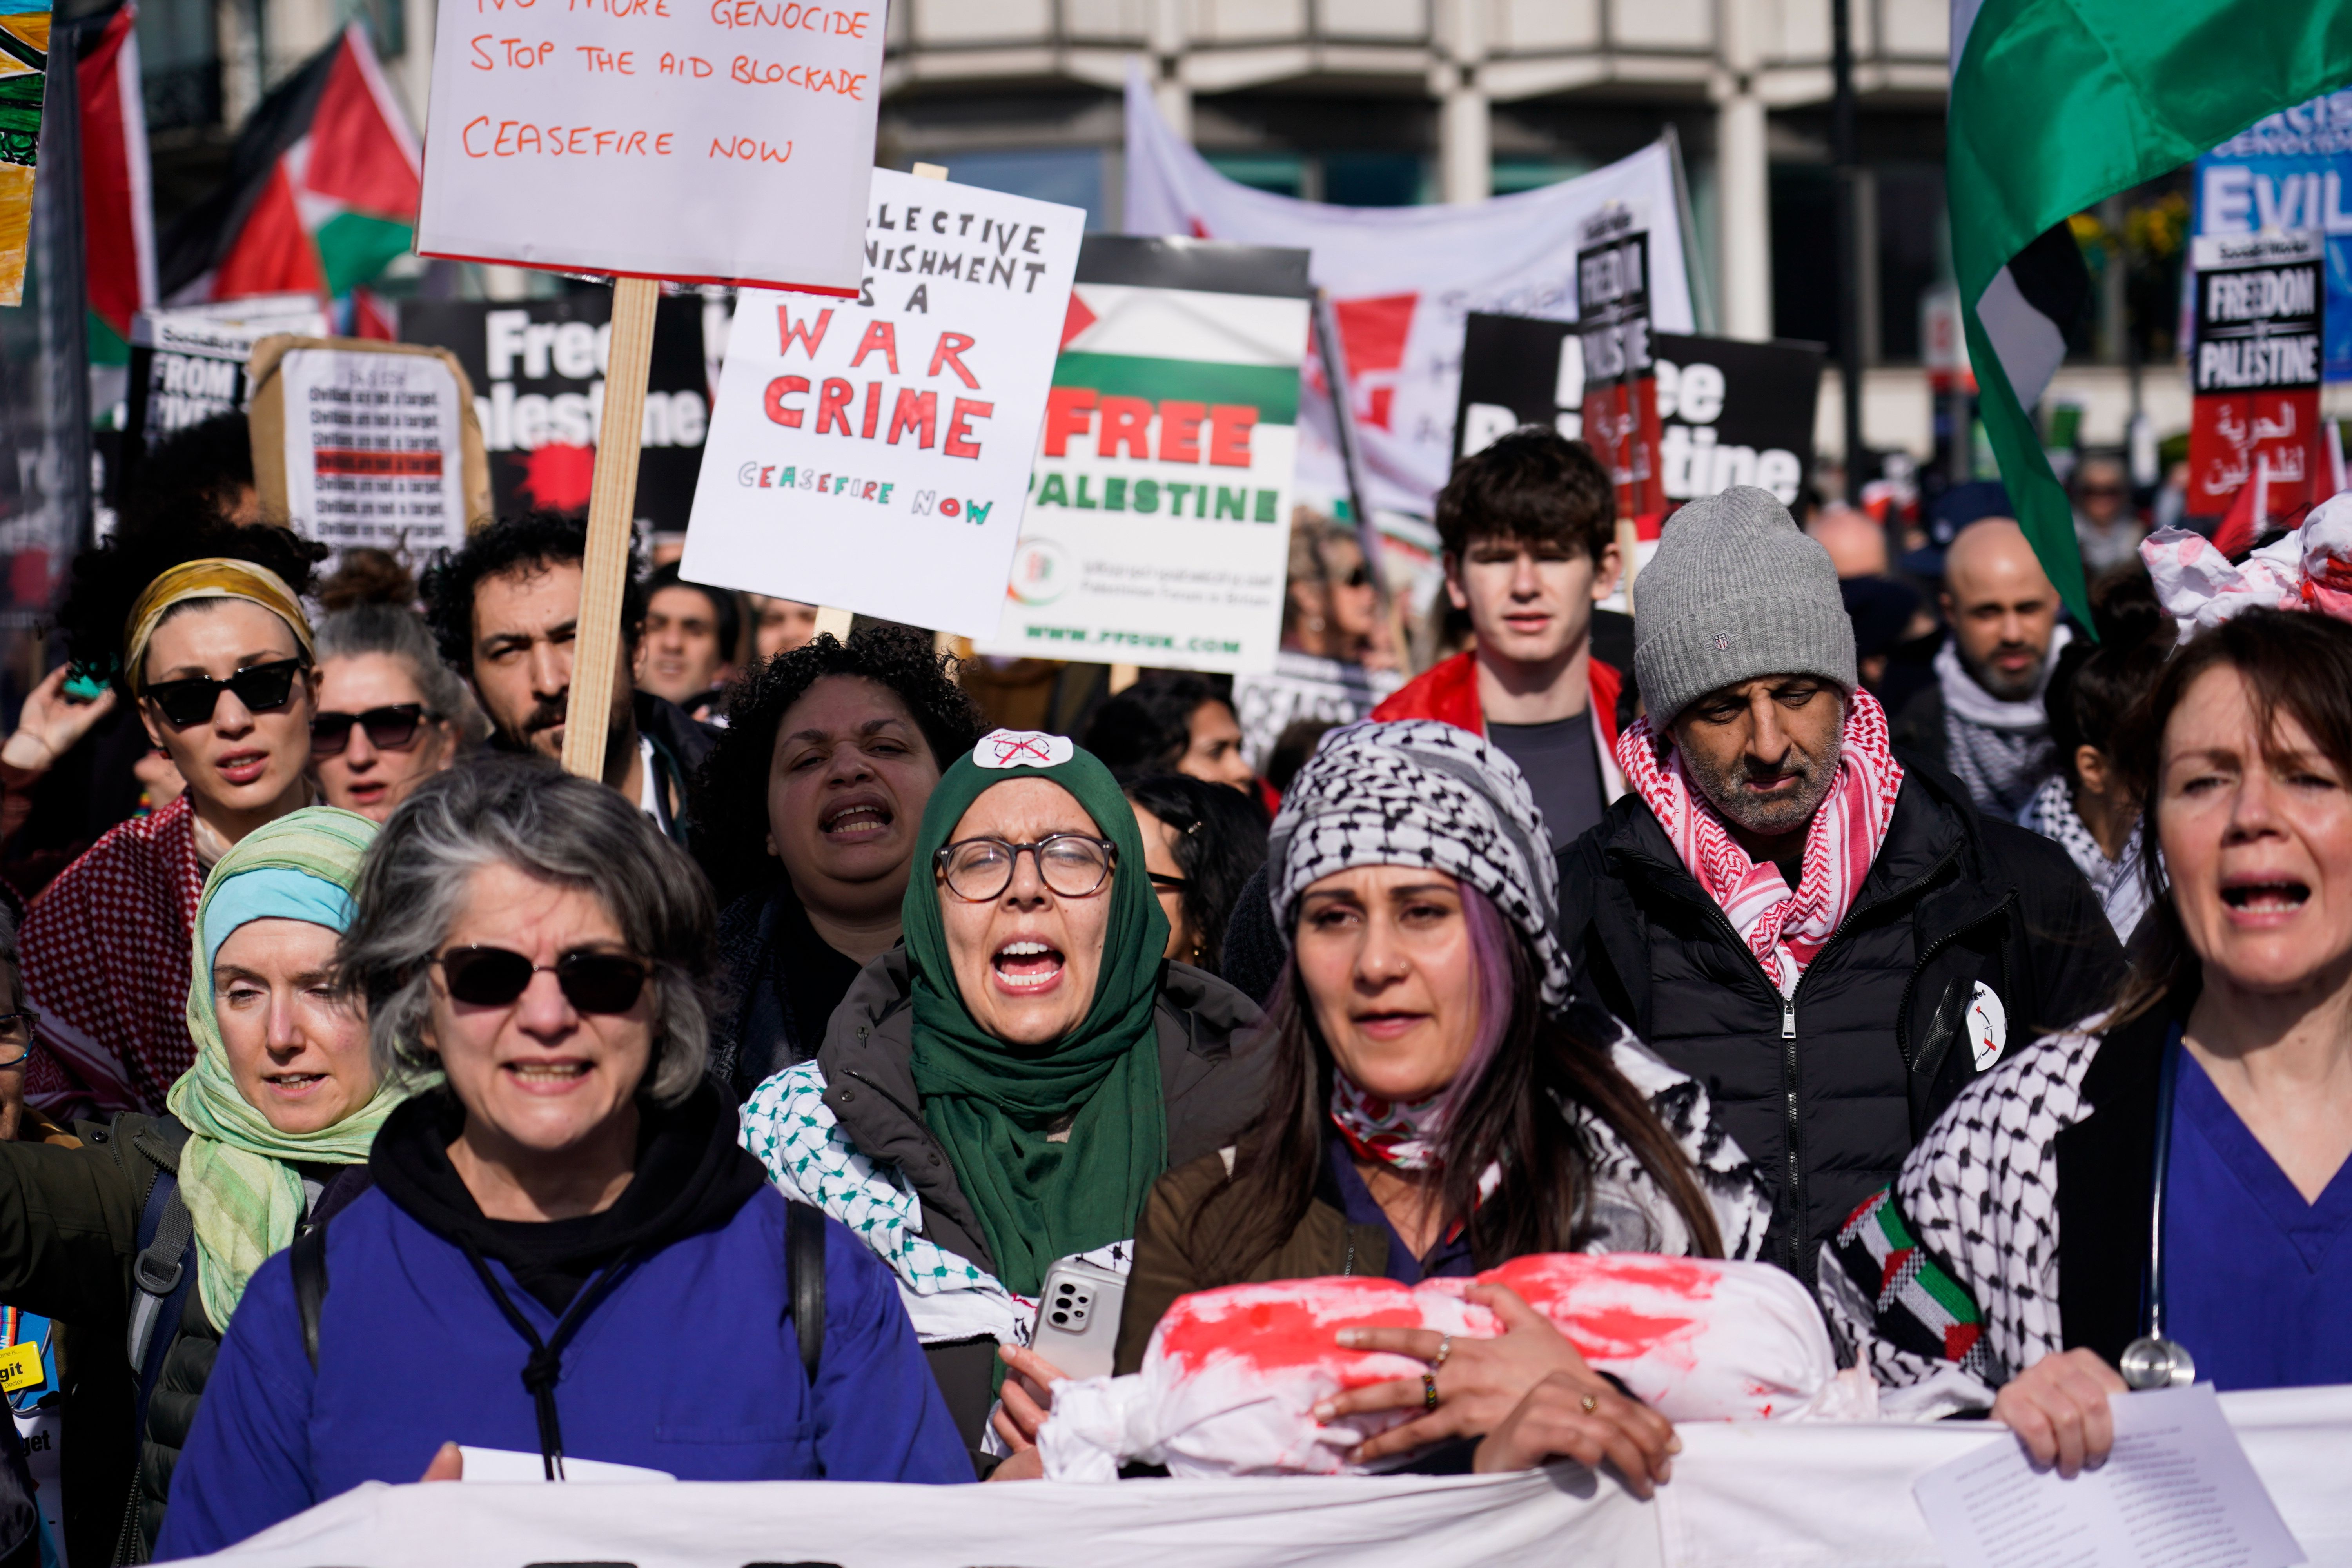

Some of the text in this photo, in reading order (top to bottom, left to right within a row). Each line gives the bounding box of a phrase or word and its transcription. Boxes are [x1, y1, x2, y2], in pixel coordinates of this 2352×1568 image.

[711, 0, 869, 38] GENOCIDE
[471, 34, 867, 100] STOP THE AID BLOCKADE
[463, 115, 793, 163] CEASEFIRE NOW
[2203, 165, 2352, 235] EVIL
[867, 203, 1045, 256] LECTIVE
[864, 240, 1045, 294] NISHMENT
[2208, 266, 2316, 323] FREEDOM
[839, 277, 928, 314] S A
[777, 305, 981, 390] WAR
[2199, 334, 2319, 389] PALESTINE
[764, 375, 994, 459] CRIME
[1044, 386, 1259, 468] FREE
[738, 461, 993, 524] CEASEFIRE NOW
[4, 1379, 23, 1388] Doctor
